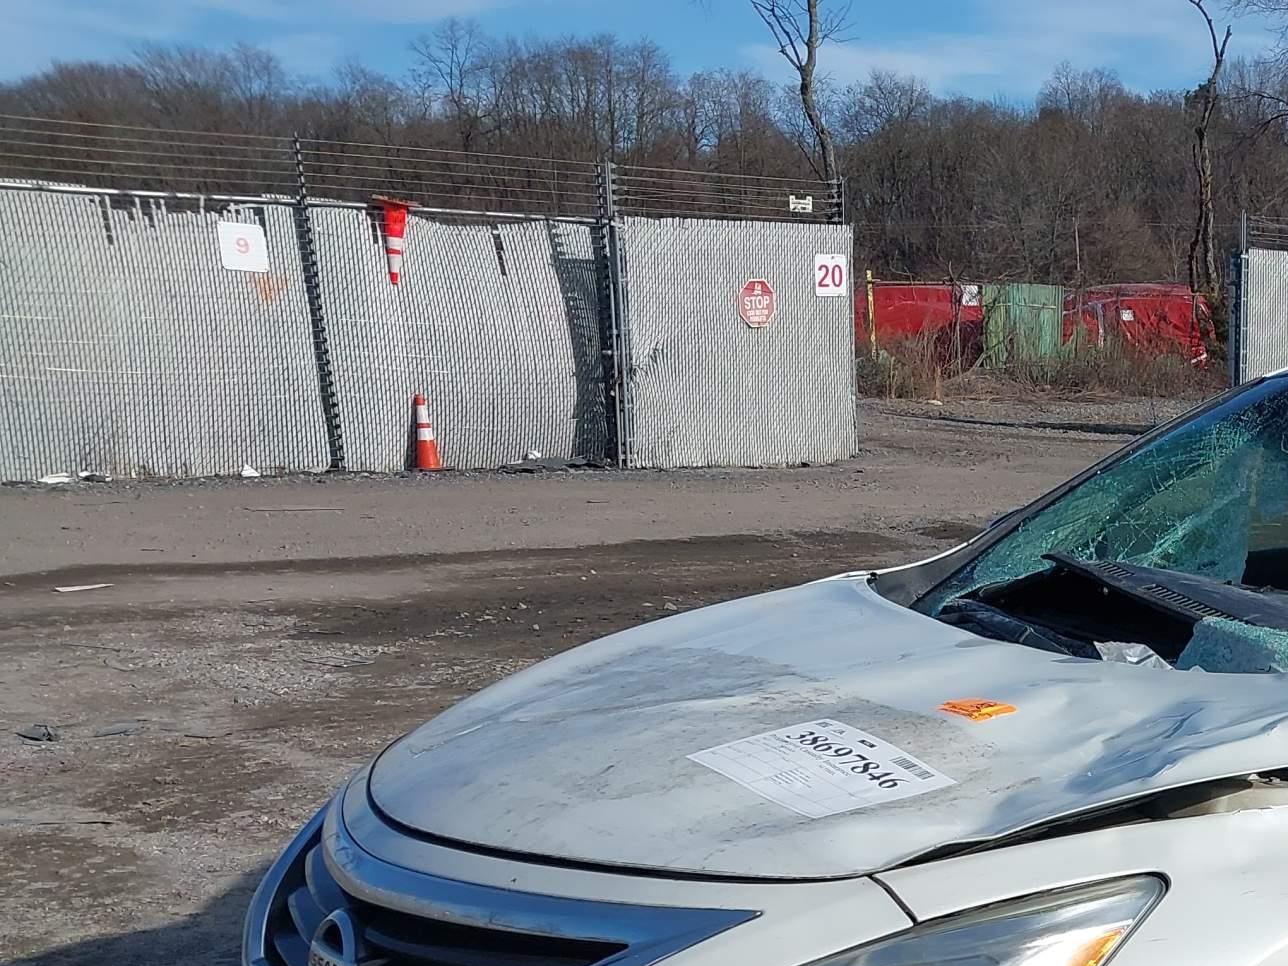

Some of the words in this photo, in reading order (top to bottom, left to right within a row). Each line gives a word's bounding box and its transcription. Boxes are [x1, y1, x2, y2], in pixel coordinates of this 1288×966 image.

[235, 237, 250, 255] 9
[817, 264, 843, 288] 20
[744, 295, 770, 310] STOP
[783, 730, 911, 789] 38697846
